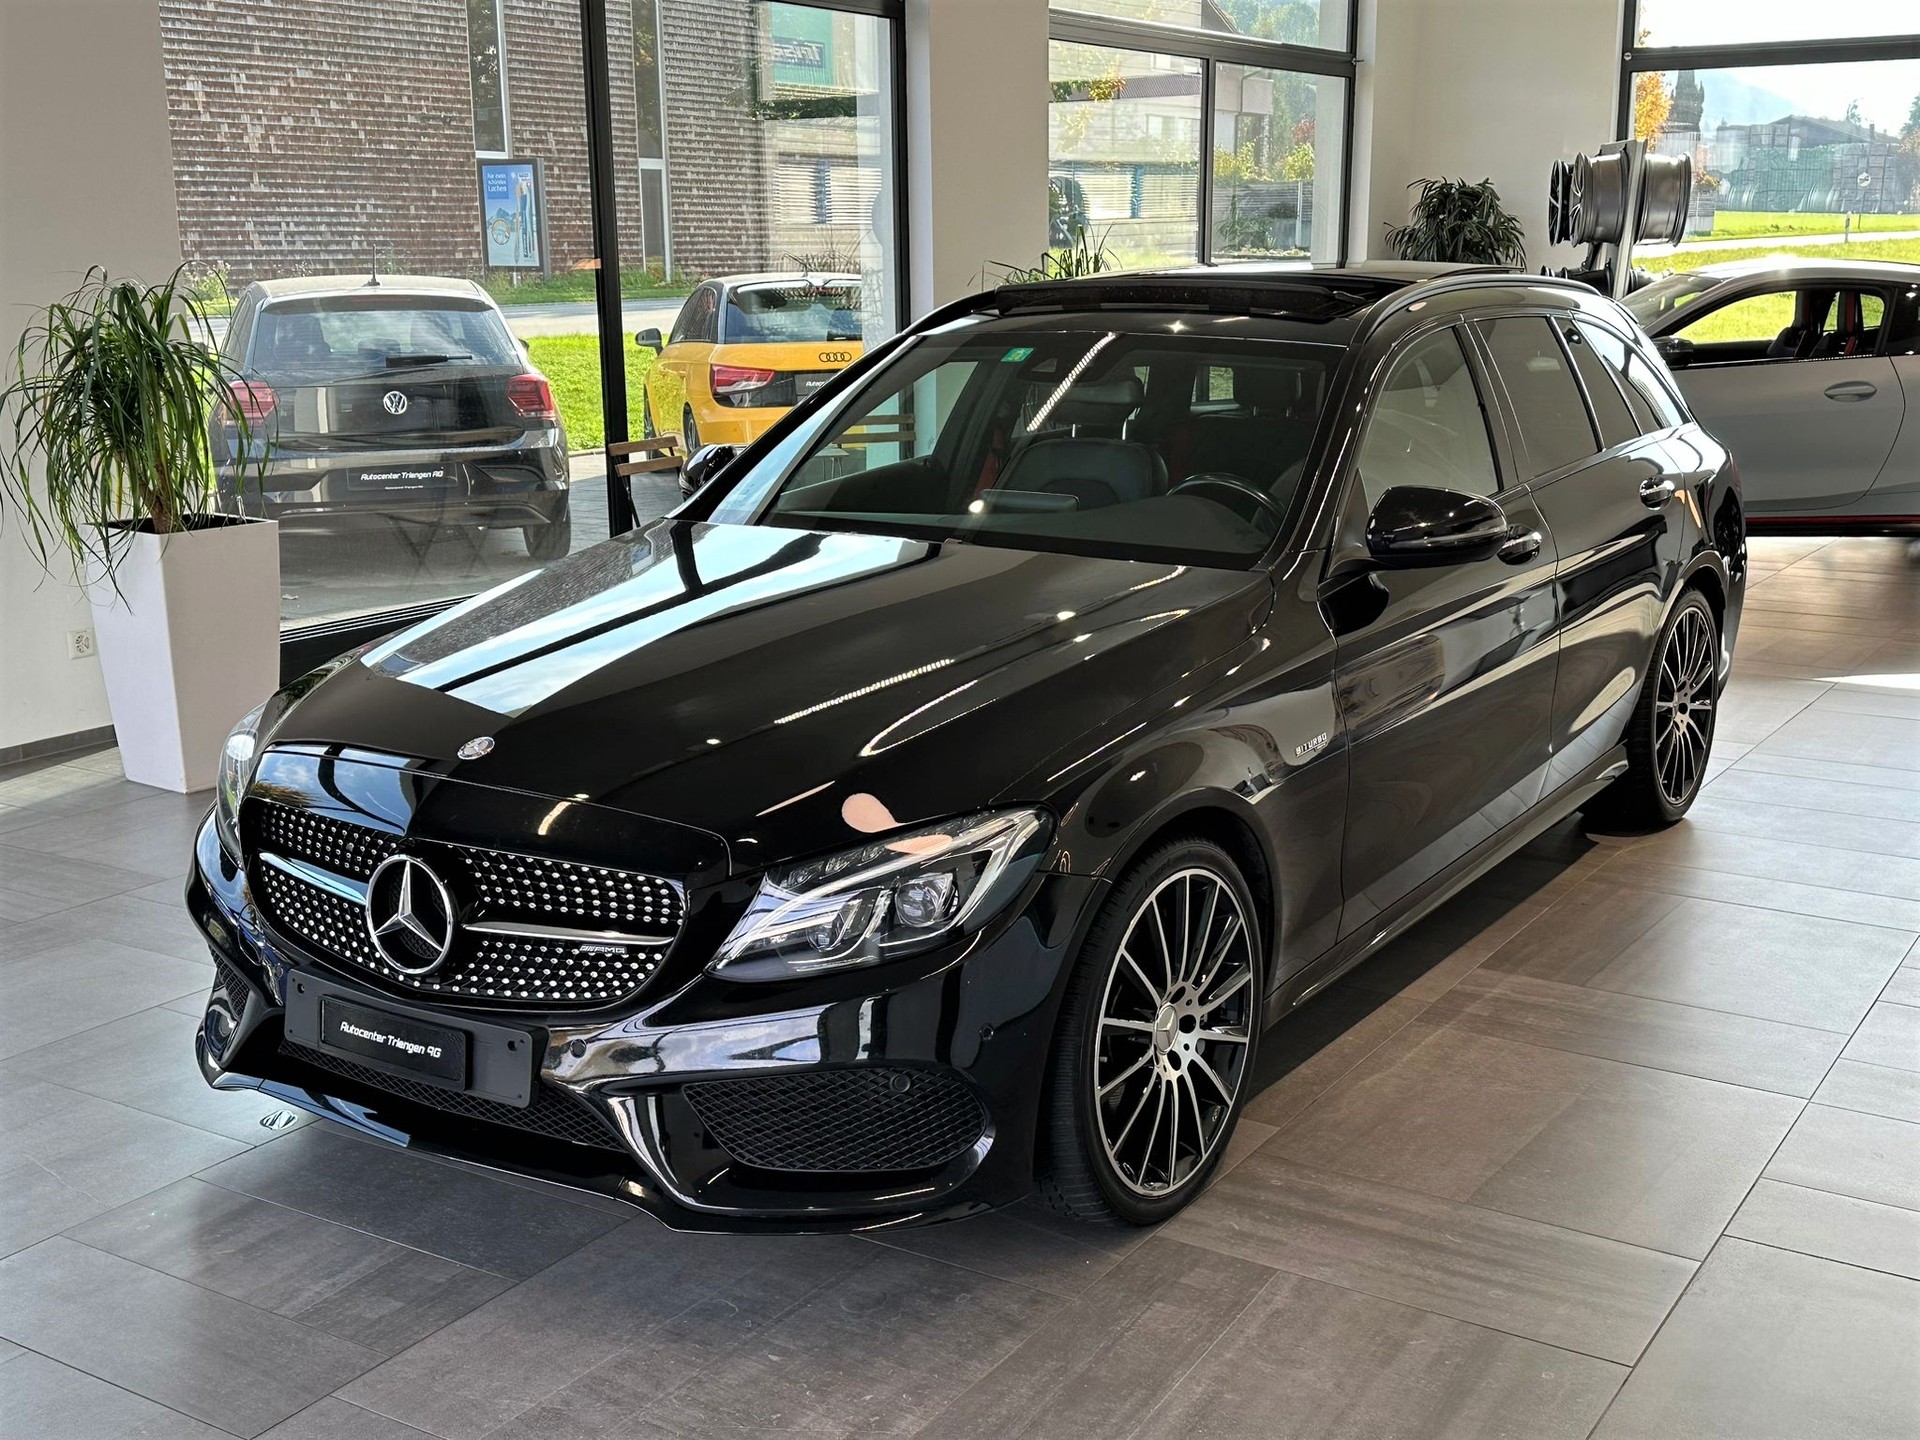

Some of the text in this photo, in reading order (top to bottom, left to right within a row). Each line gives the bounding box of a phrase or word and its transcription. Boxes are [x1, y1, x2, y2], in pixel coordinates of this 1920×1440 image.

[360, 472, 401, 481] Autocenter
[401, 471, 431, 480] Triengen
[1295, 732, 1327, 755] BITURBO
[340, 1021, 387, 1044] Autocenter
[387, 1034, 426, 1055] Triengen
